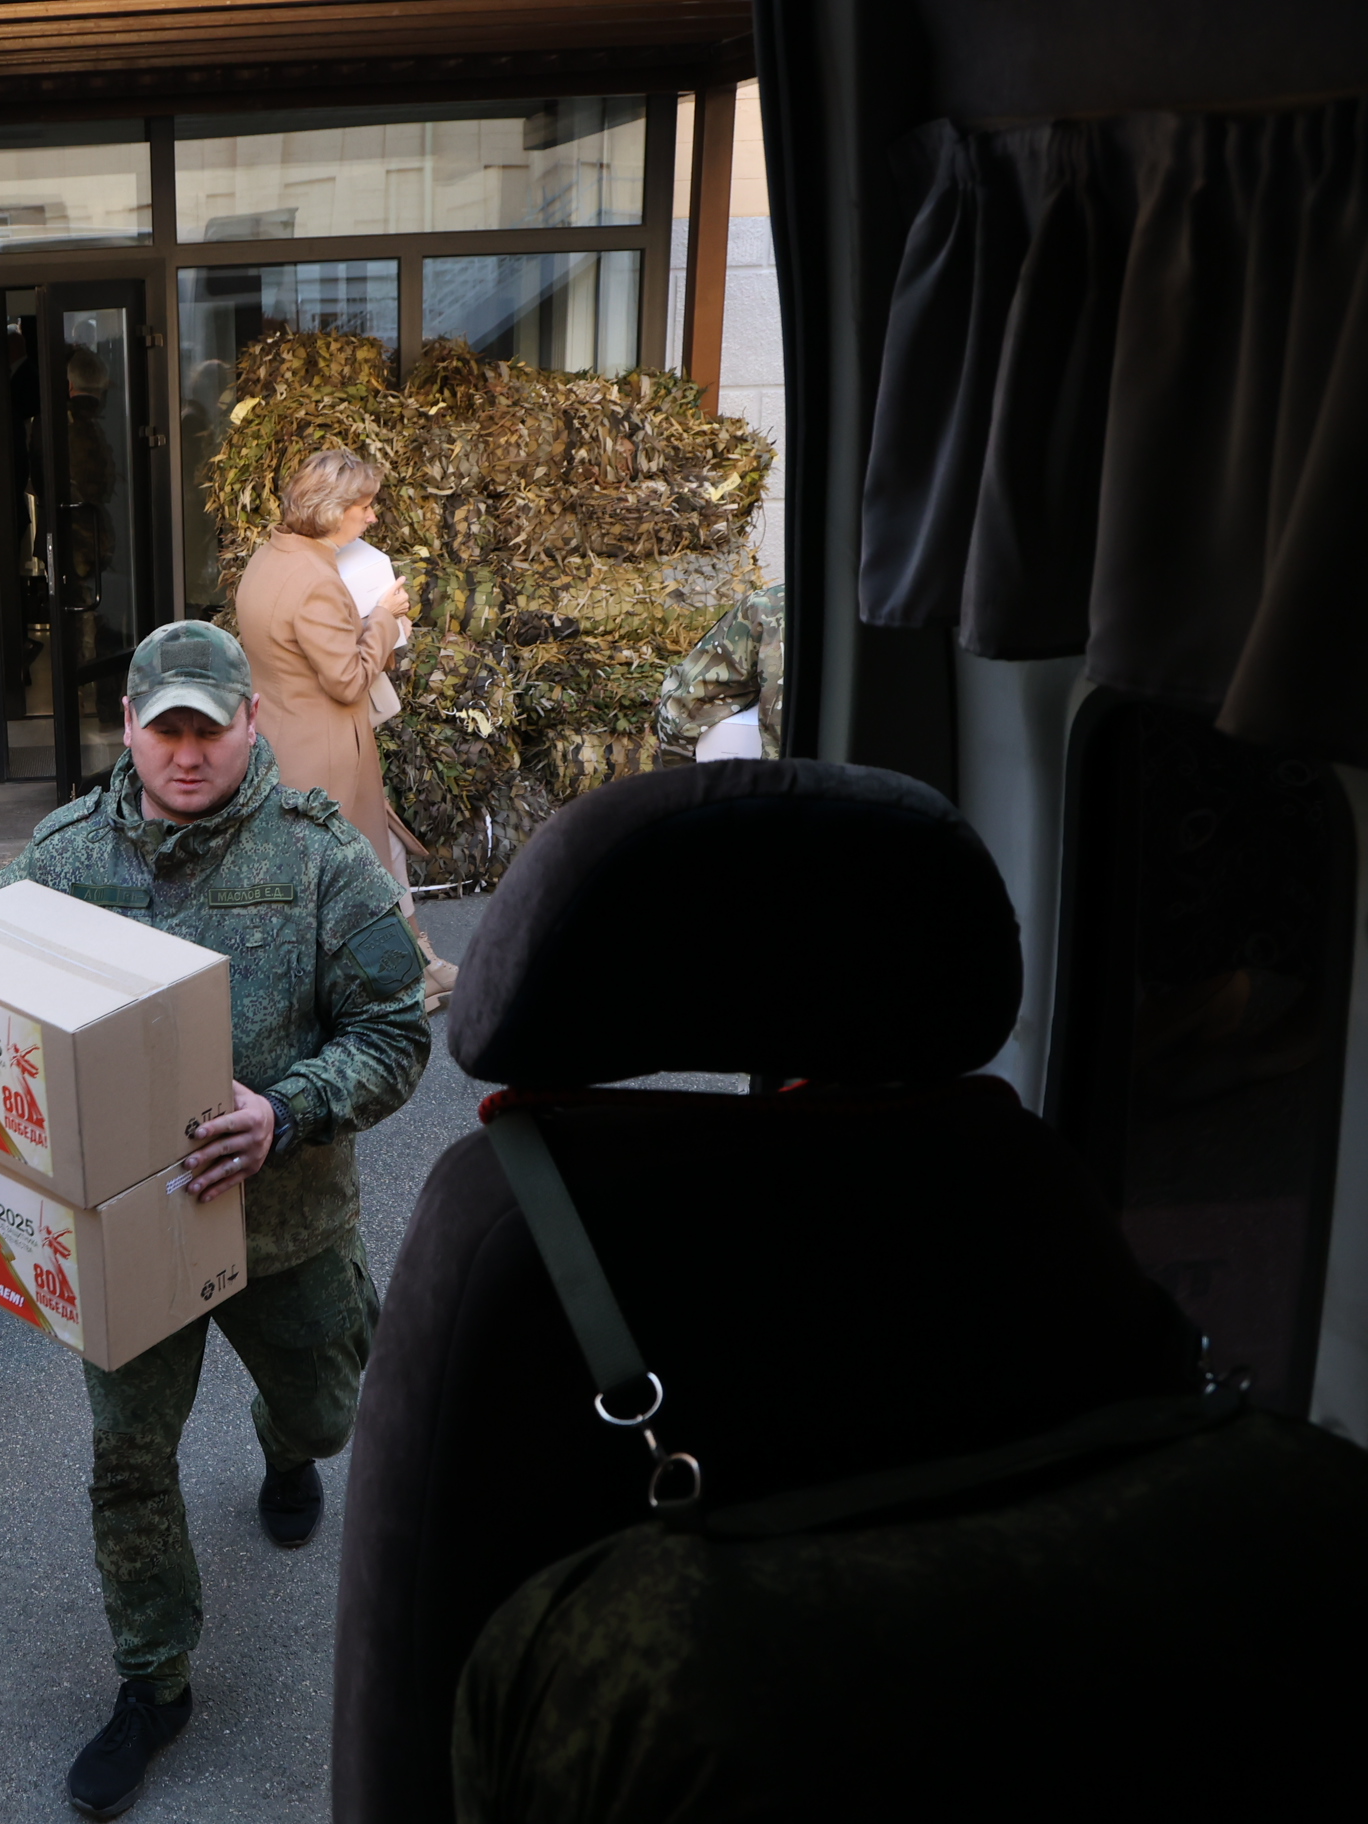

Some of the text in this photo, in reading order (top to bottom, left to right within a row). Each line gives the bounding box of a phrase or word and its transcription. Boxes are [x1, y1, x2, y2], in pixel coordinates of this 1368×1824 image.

[217, 889, 261, 902] МАСЛОВ
[2, 1085, 28, 1120] 80
[4, 1115, 48, 1149] ПОБЕДА!
[33, 1263, 60, 1297] 80
[36, 1290, 80, 1325] ПОБЕДА!
